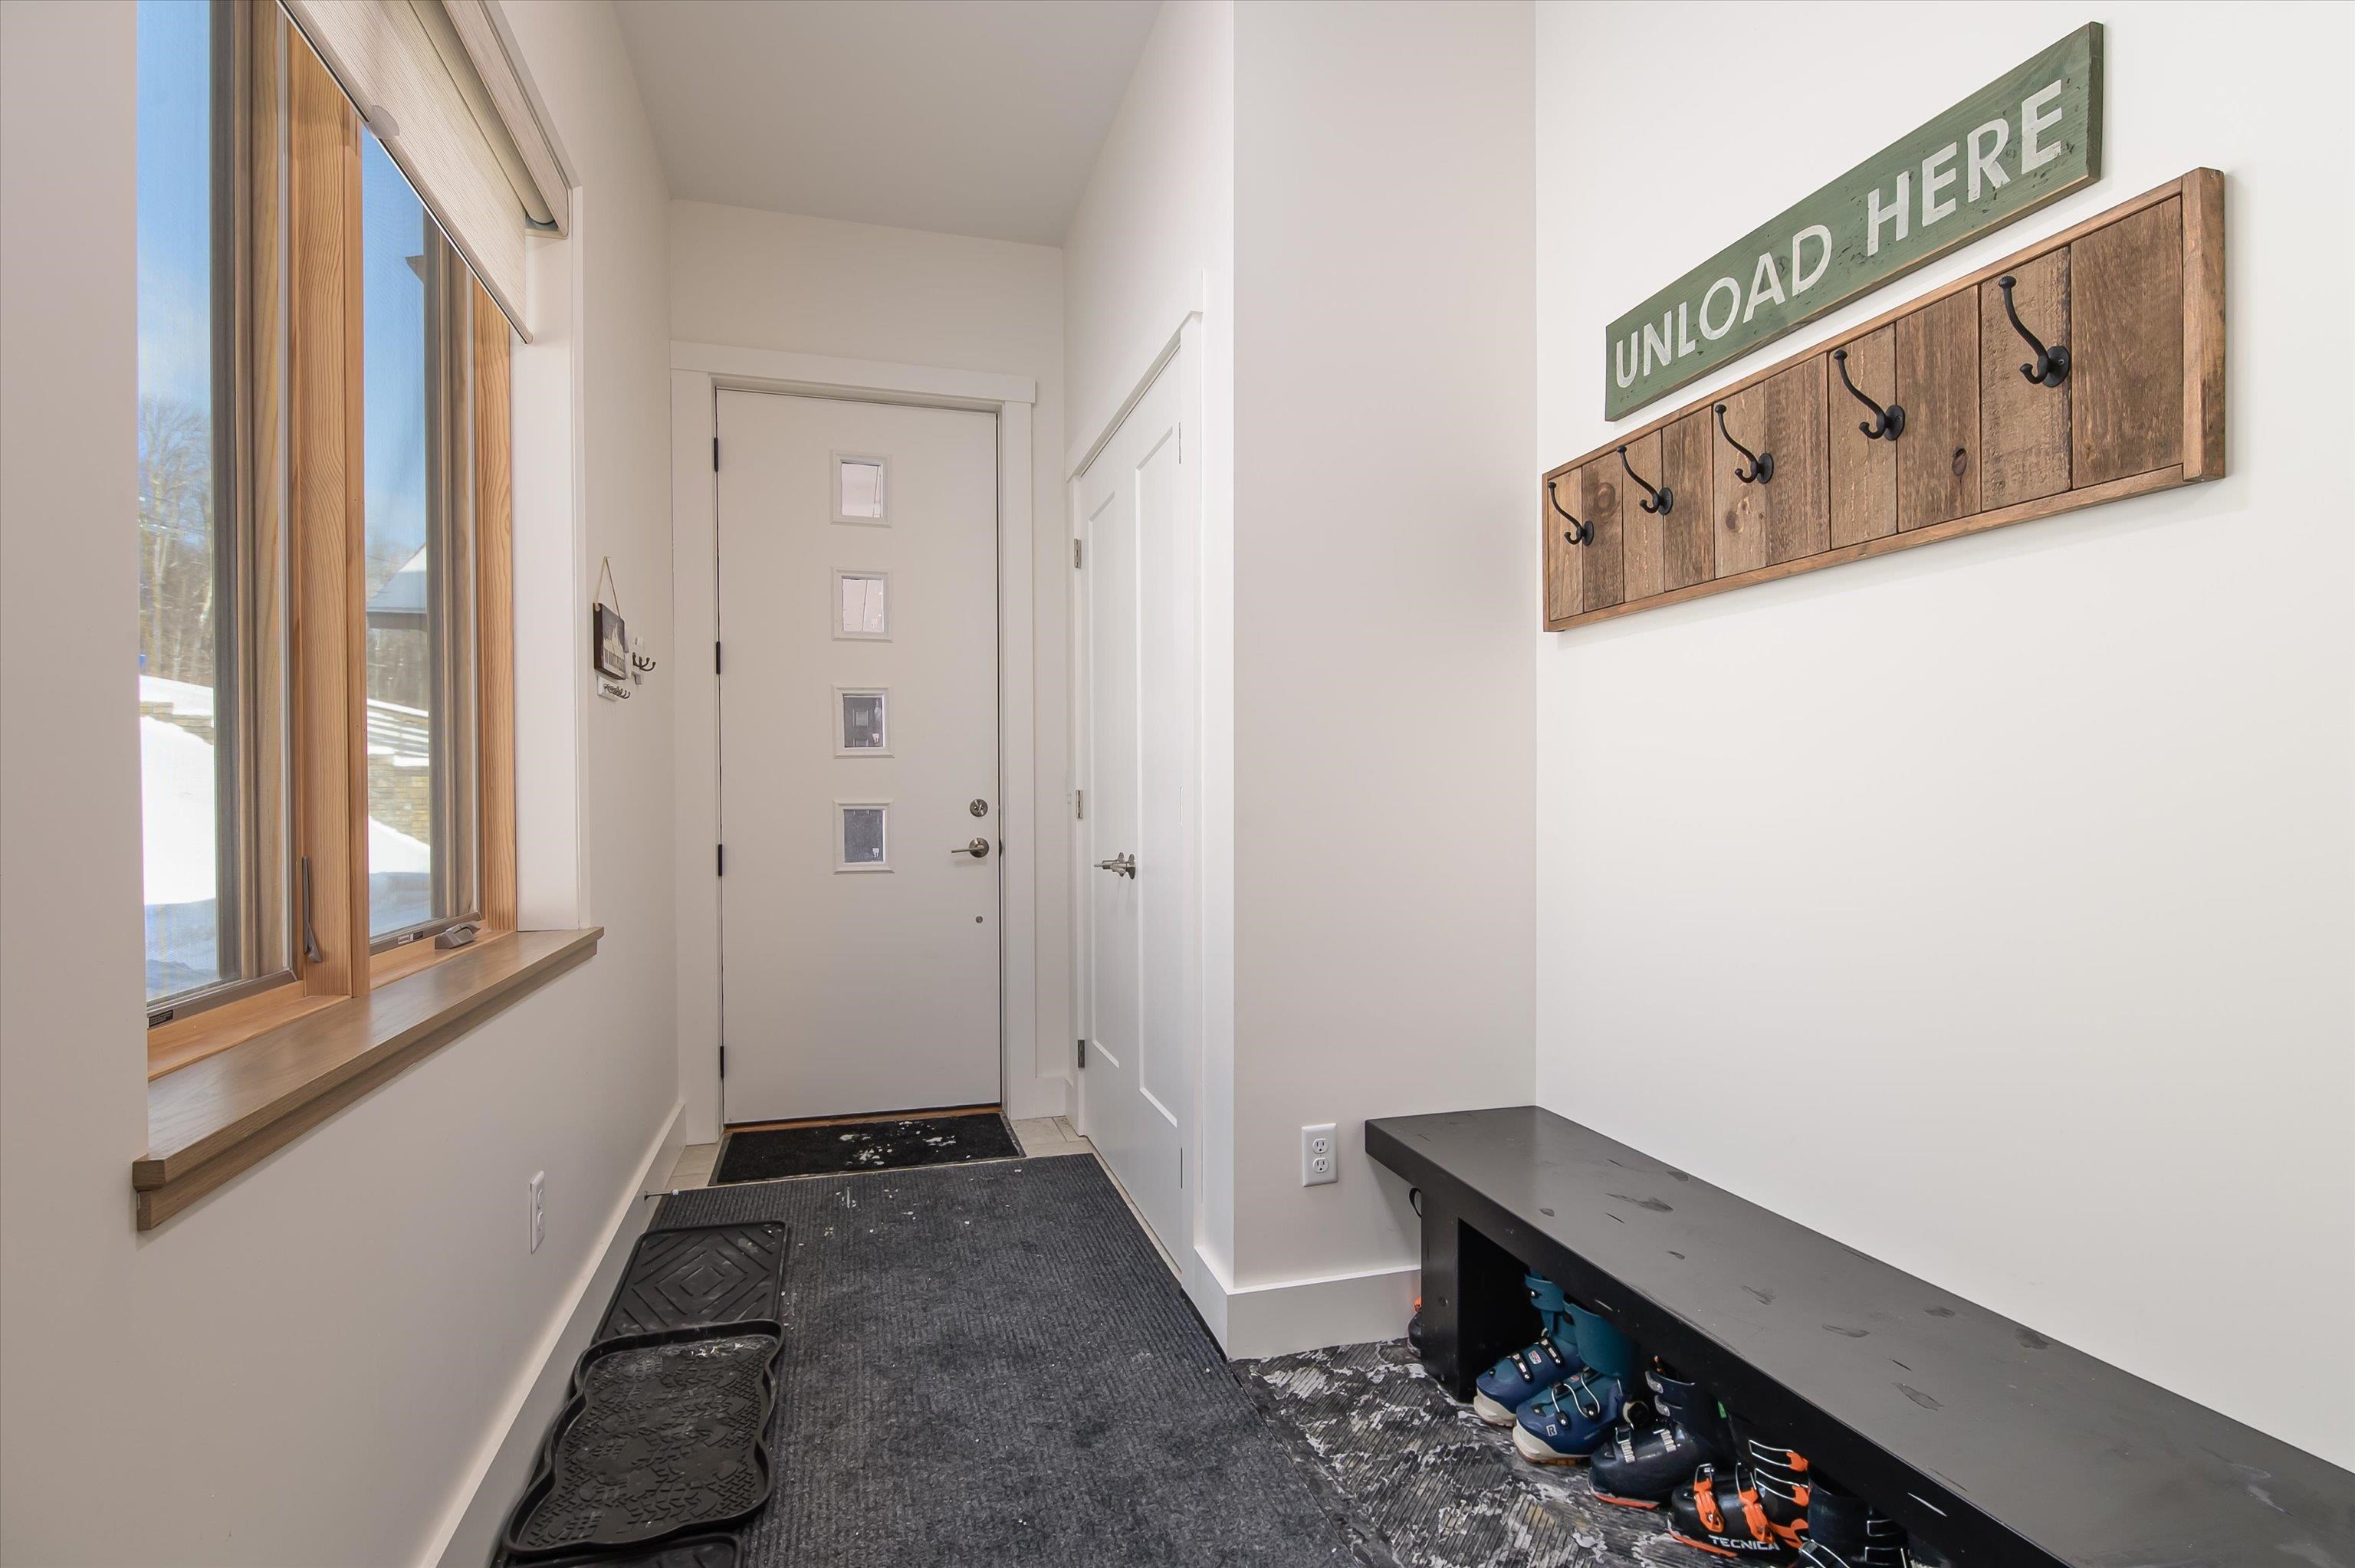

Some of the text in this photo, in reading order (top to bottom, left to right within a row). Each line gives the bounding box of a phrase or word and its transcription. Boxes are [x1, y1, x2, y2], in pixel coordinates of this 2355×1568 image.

[1616, 80, 2063, 388] UNLOAD HERE
[1708, 1534, 1780, 1550] TECNICA
